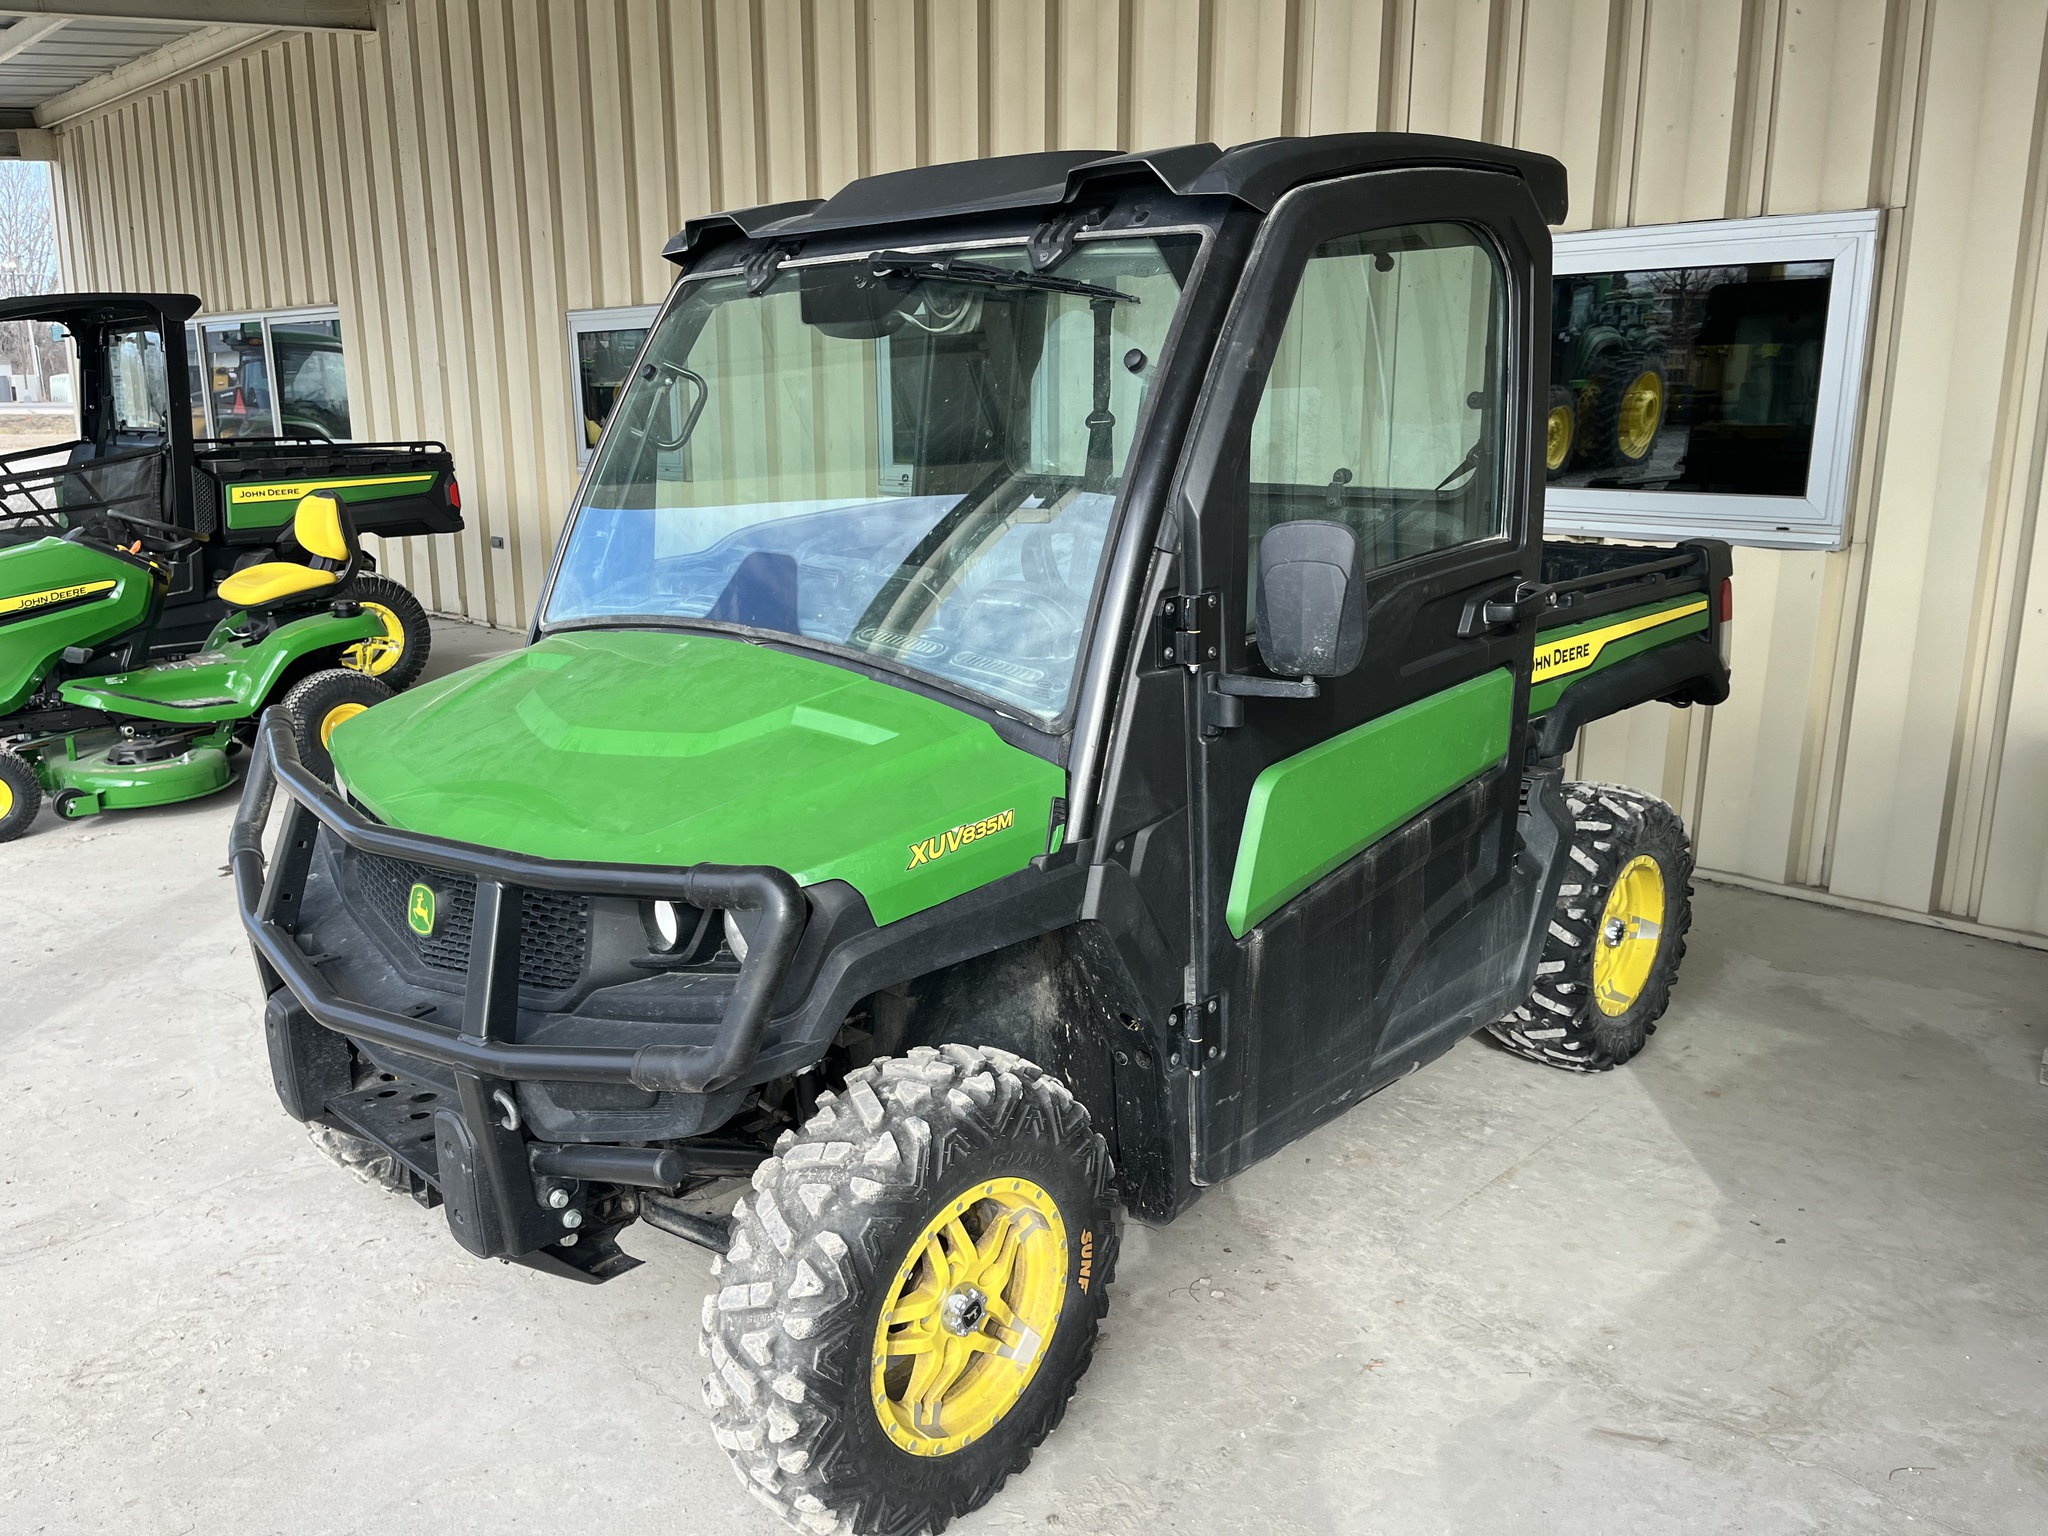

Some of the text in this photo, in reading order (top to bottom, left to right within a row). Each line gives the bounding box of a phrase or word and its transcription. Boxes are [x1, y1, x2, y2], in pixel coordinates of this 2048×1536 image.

[240, 488, 300, 498] JOHN DEERE
[18, 587, 87, 609] JOHN DEERE
[1553, 642, 1590, 666] DEERE
[906, 808, 1015, 871] XUV835M
[1077, 1228, 1093, 1296] SUNF
